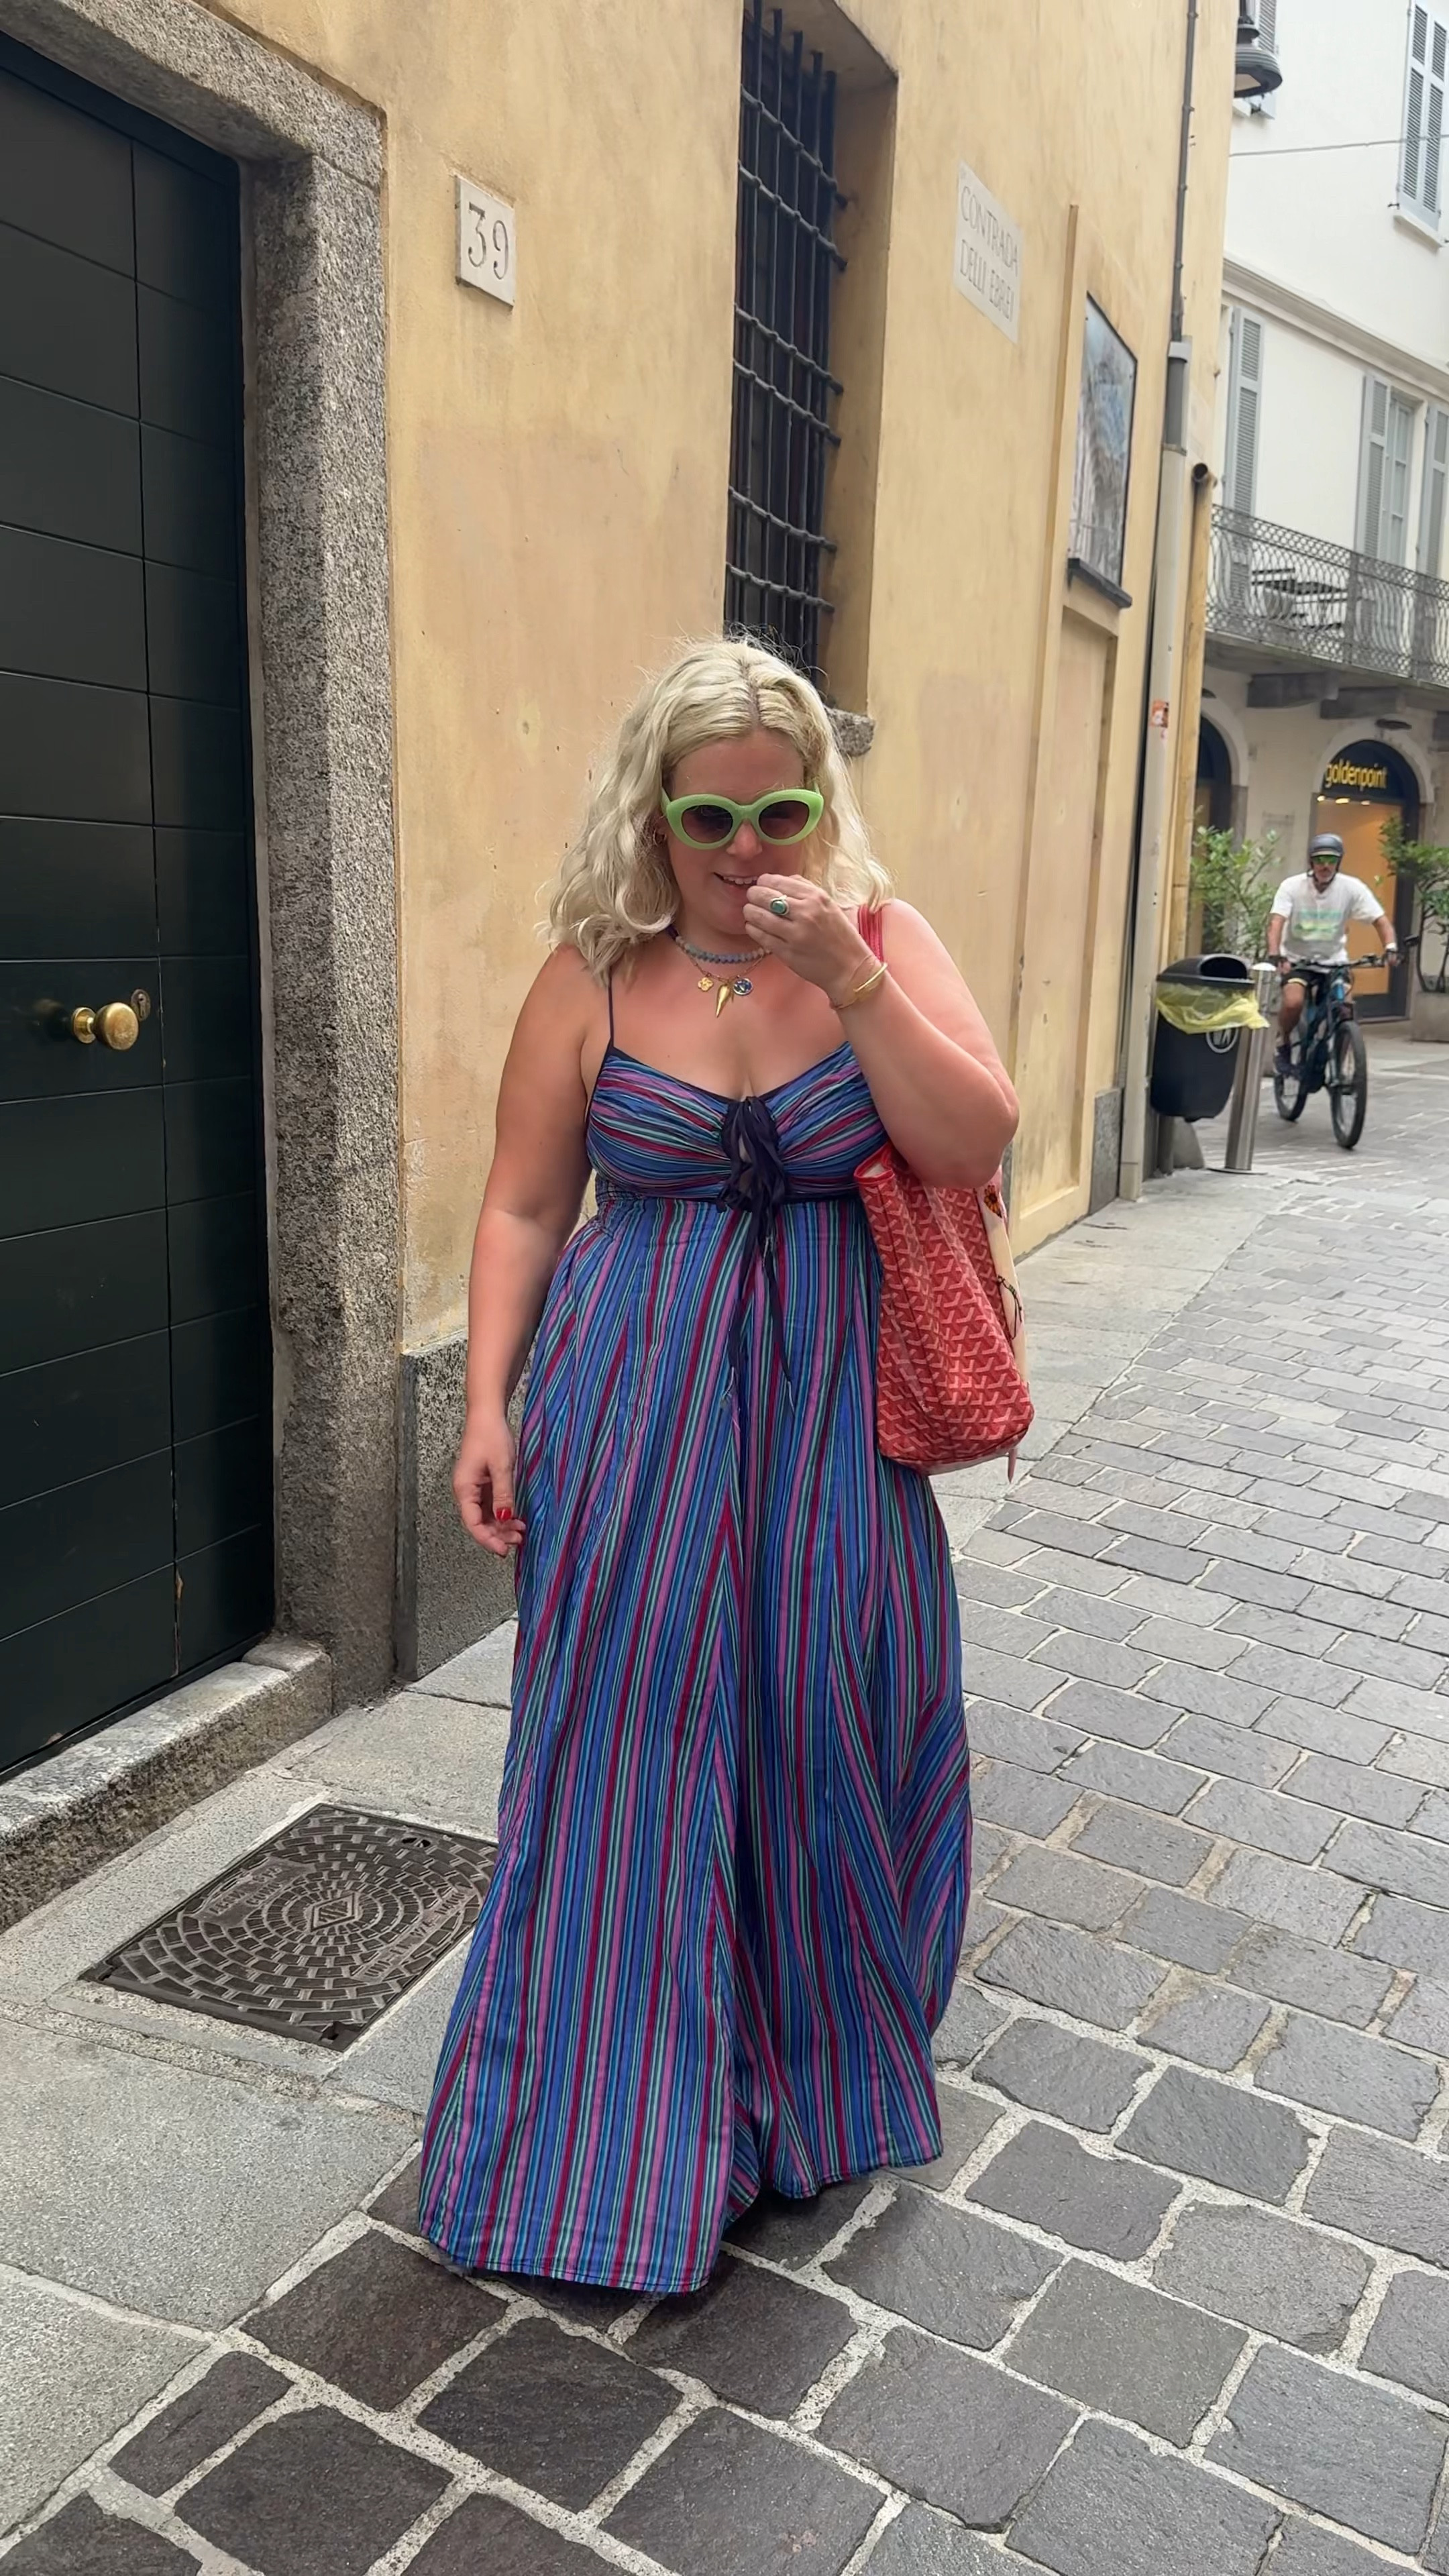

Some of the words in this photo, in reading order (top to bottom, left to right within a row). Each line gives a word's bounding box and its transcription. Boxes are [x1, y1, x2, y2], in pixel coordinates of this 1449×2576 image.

[468, 201, 509, 280] 39
[961, 185, 1018, 278] CONTRADA
[1325, 758, 1387, 792] goldenpoint
